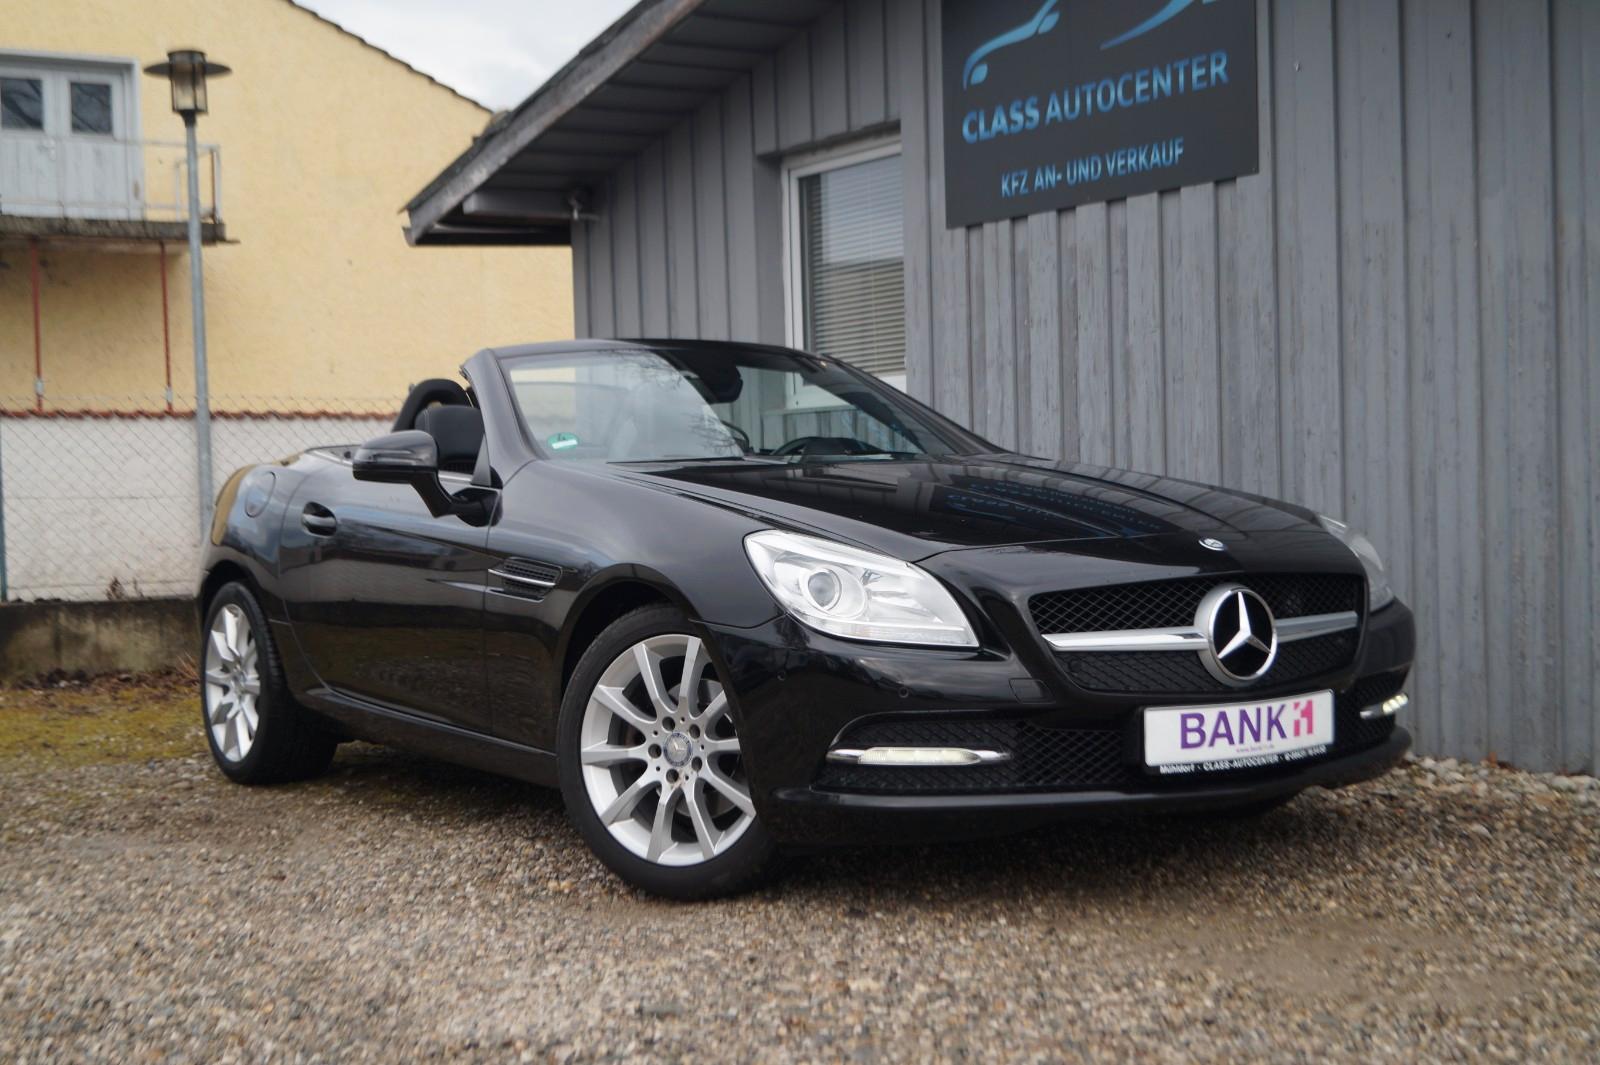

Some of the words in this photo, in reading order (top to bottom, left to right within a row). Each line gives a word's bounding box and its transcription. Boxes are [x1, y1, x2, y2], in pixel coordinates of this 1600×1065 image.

[962, 95, 1040, 144] CLASS
[1044, 49, 1229, 126] AUTOCENTER
[1001, 172, 1029, 198] KFZ
[1034, 163, 1062, 192] AN-
[1066, 153, 1102, 185] UND
[1105, 136, 1185, 177] VERKAUF
